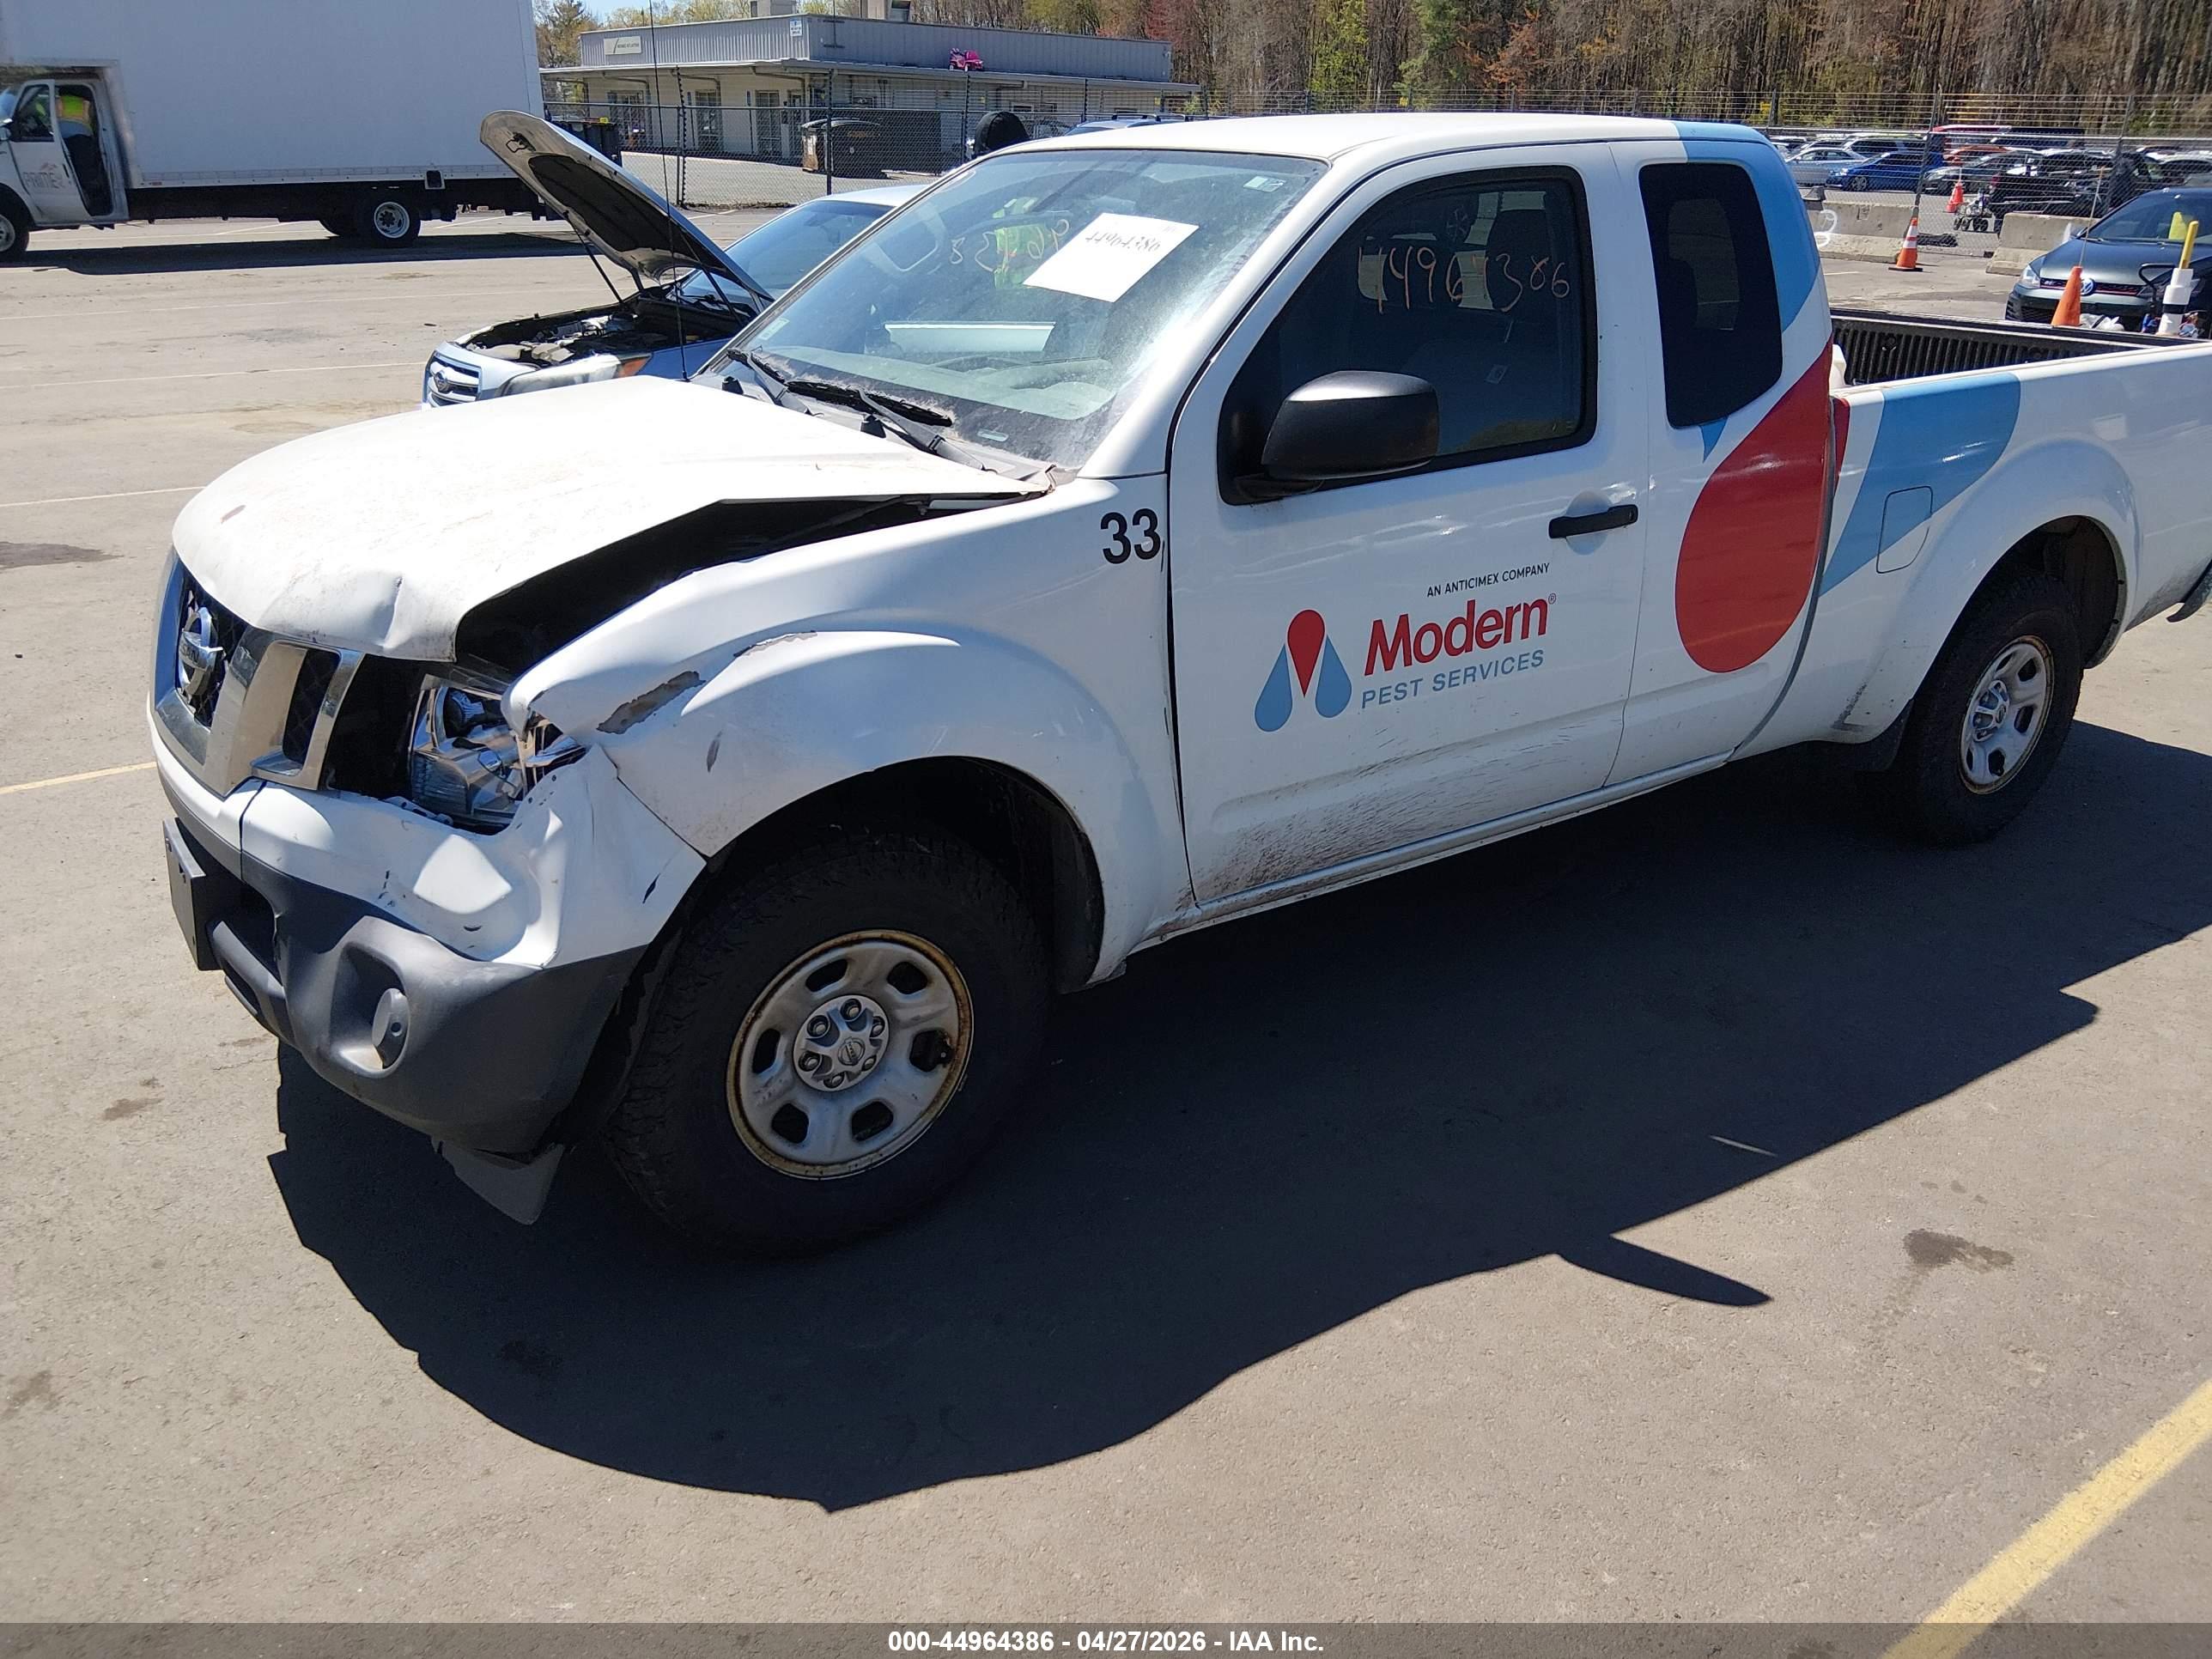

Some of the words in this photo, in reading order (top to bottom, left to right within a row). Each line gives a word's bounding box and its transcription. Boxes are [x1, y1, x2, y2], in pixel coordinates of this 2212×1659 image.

[1100, 507, 1161, 564] 33
[1427, 585, 1442, 597] AN
[1444, 572, 1499, 594] ANTICIMEX
[1502, 562, 1550, 581] COMPANY
[1364, 599, 1548, 677] Modern
[1361, 678, 1424, 709] PEST
[1432, 649, 1544, 691] SERVICES
